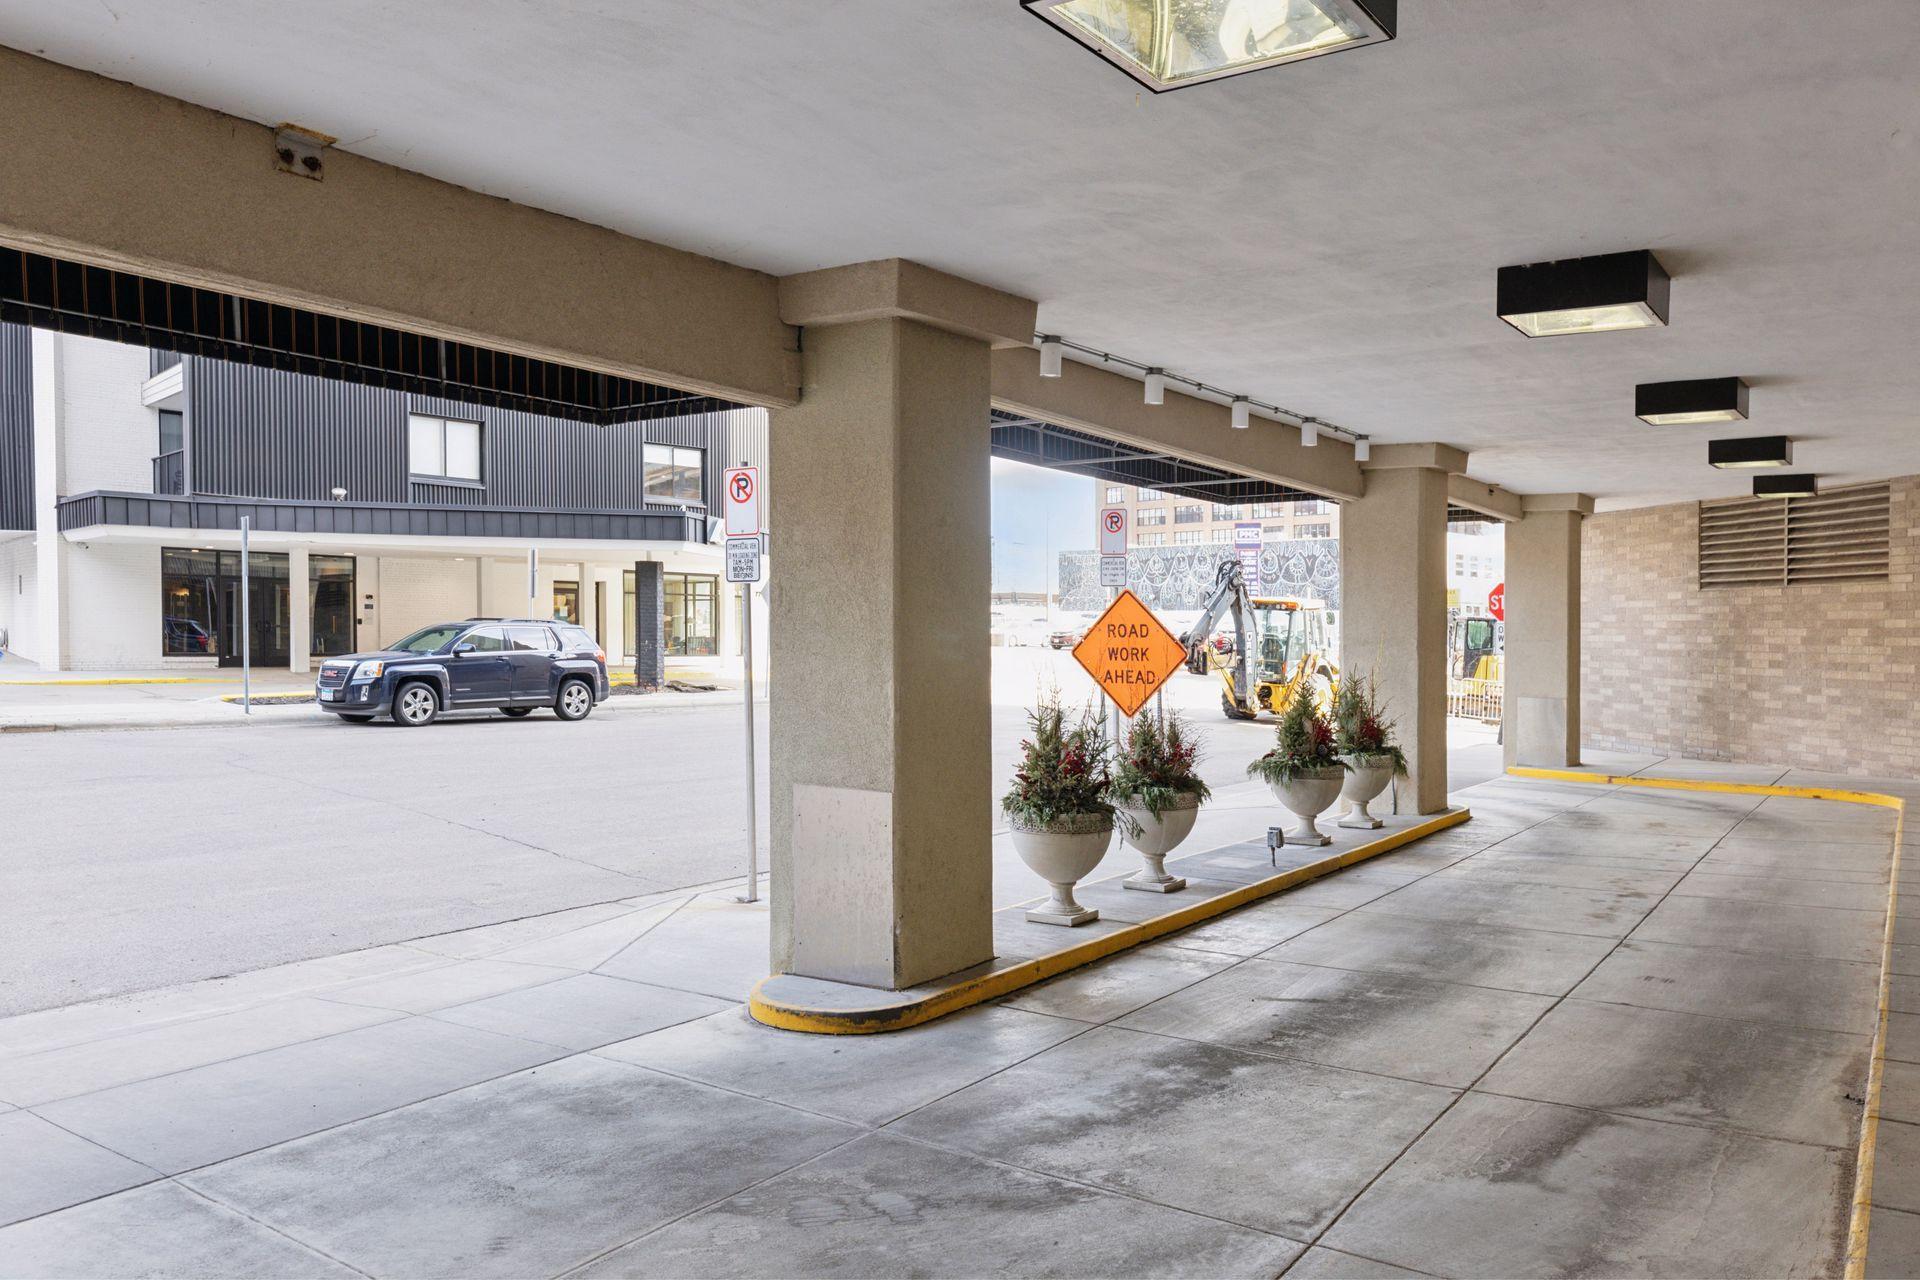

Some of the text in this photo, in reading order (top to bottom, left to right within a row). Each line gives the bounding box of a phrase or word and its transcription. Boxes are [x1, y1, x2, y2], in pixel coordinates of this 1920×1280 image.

[1107, 624, 1149, 638] ROAD
[1107, 647, 1149, 661] WORK
[1103, 670, 1155, 685] AHEAD
